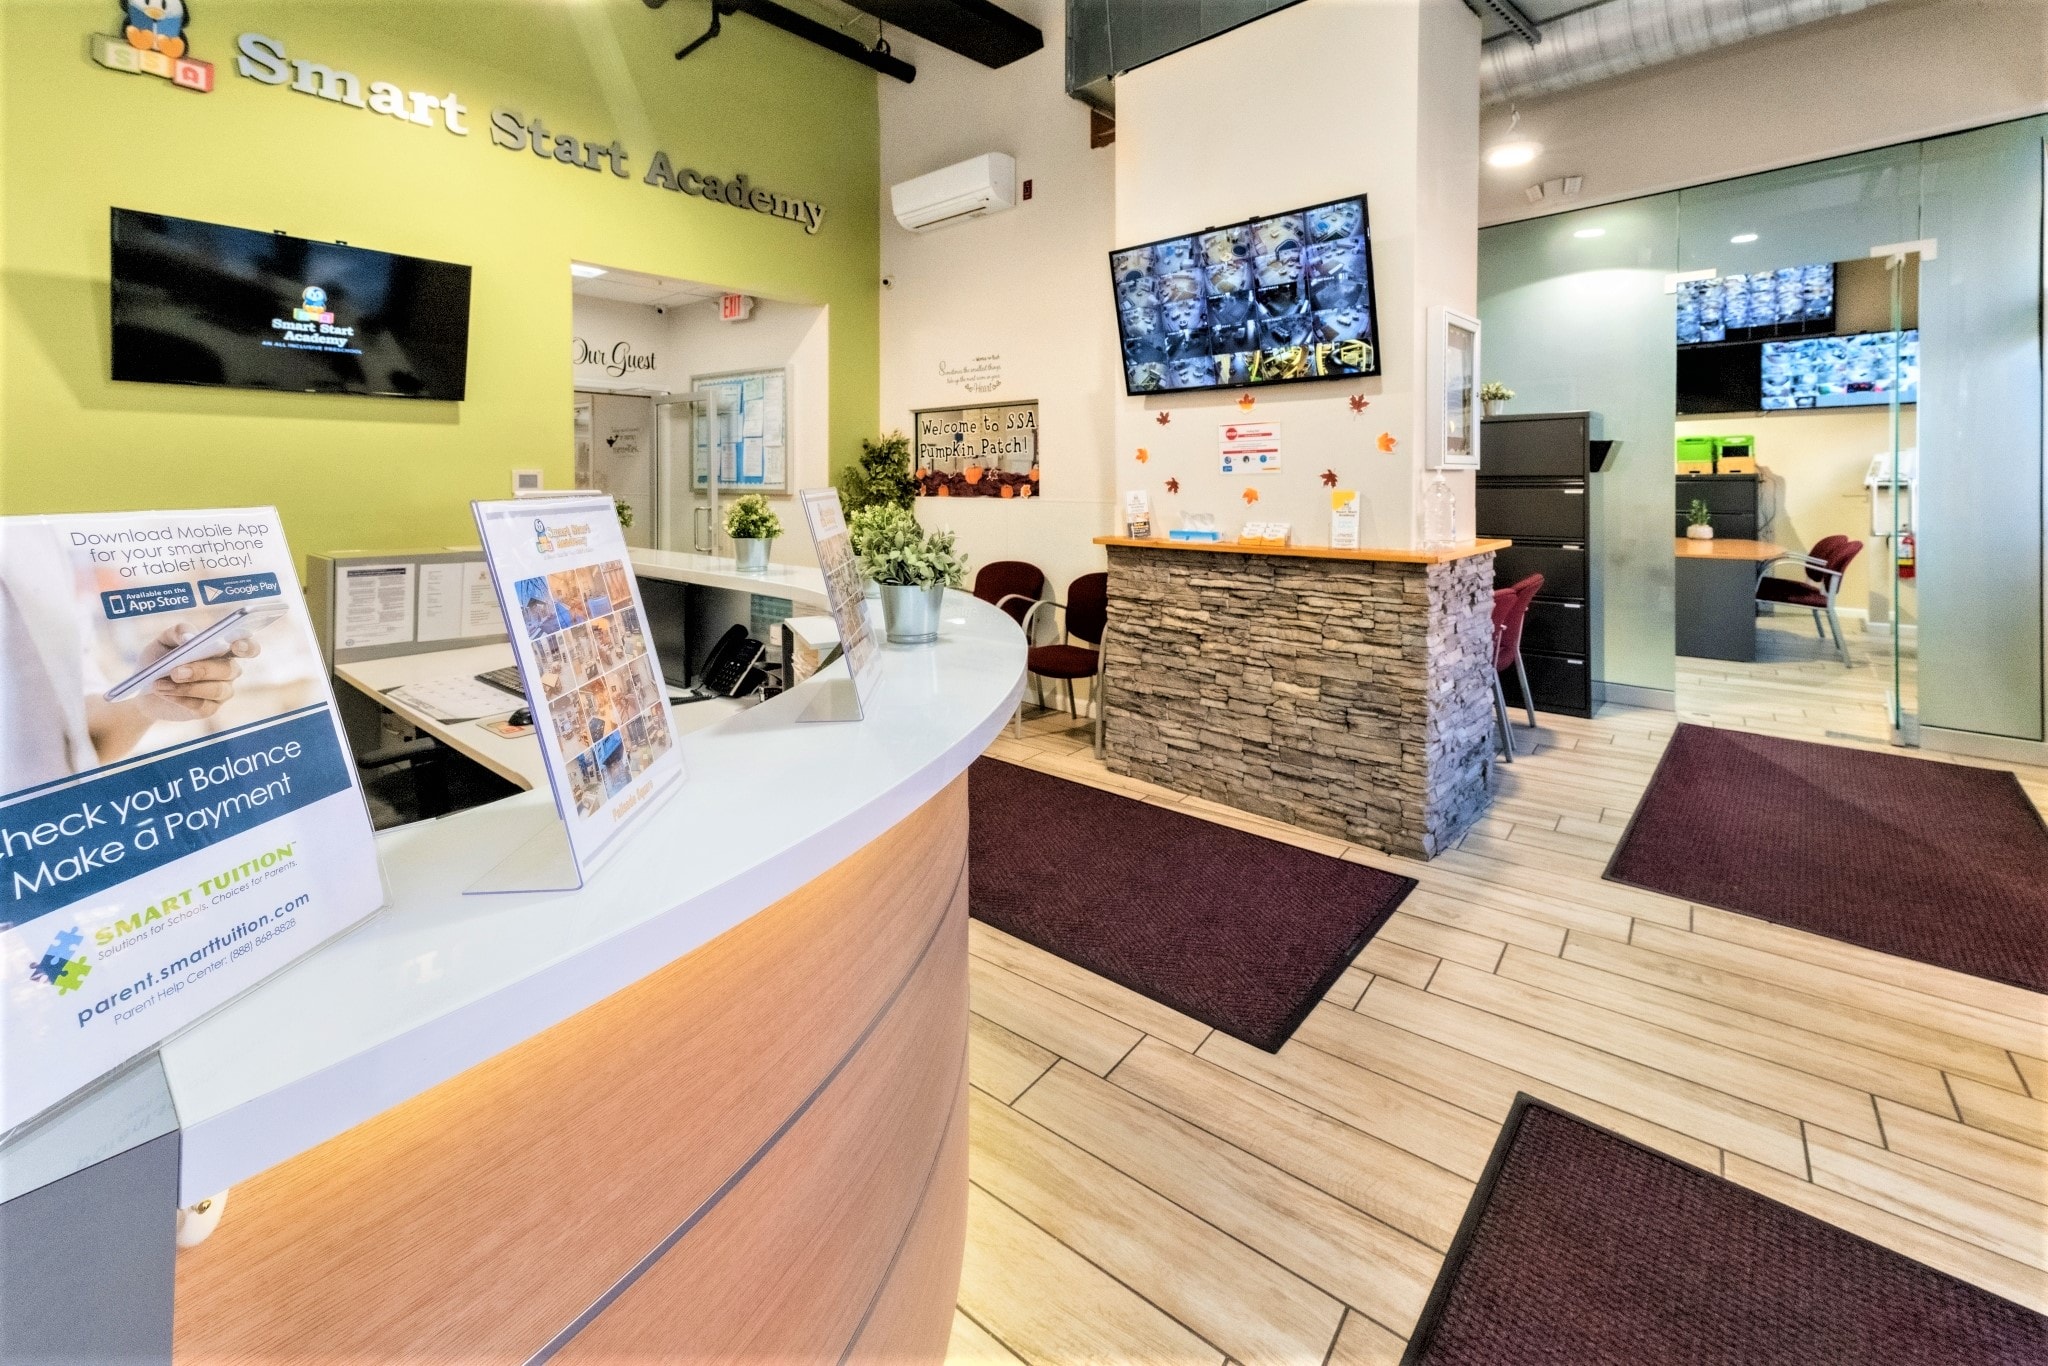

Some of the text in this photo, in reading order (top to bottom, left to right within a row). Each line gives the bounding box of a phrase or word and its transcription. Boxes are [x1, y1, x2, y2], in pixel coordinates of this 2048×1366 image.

[236, 32, 827, 234] Smart Start Academy
[723, 294, 741, 318] EXIT
[271, 318, 354, 336] Smart Start
[283, 330, 348, 348] Academy
[606, 341, 657, 377] Guest
[921, 411, 1036, 435] Welcome to SSA
[920, 437, 1028, 462] Pumpkin Patch!
[70, 523, 269, 546] Download Mobile App
[90, 538, 264, 563] for your smartphone
[119, 553, 252, 578] or tablet today!
[126, 586, 186, 600] Available on the
[225, 581, 277, 596] Google Play
[129, 594, 189, 612] App Store
[0, 741, 302, 860] heck your Balance
[13, 841, 125, 900] Make
[164, 772, 292, 839] Payment
[95, 889, 193, 946] SMART
[98, 861, 298, 960] Solutions for Schools. Choices for Parents.
[78, 893, 310, 1028] parent.smarttuition.com
[114, 997, 155, 1025] Parent
[157, 981, 185, 1002] Help
[186, 957, 228, 984] Center:
[230, 941, 253, 962] (888)
